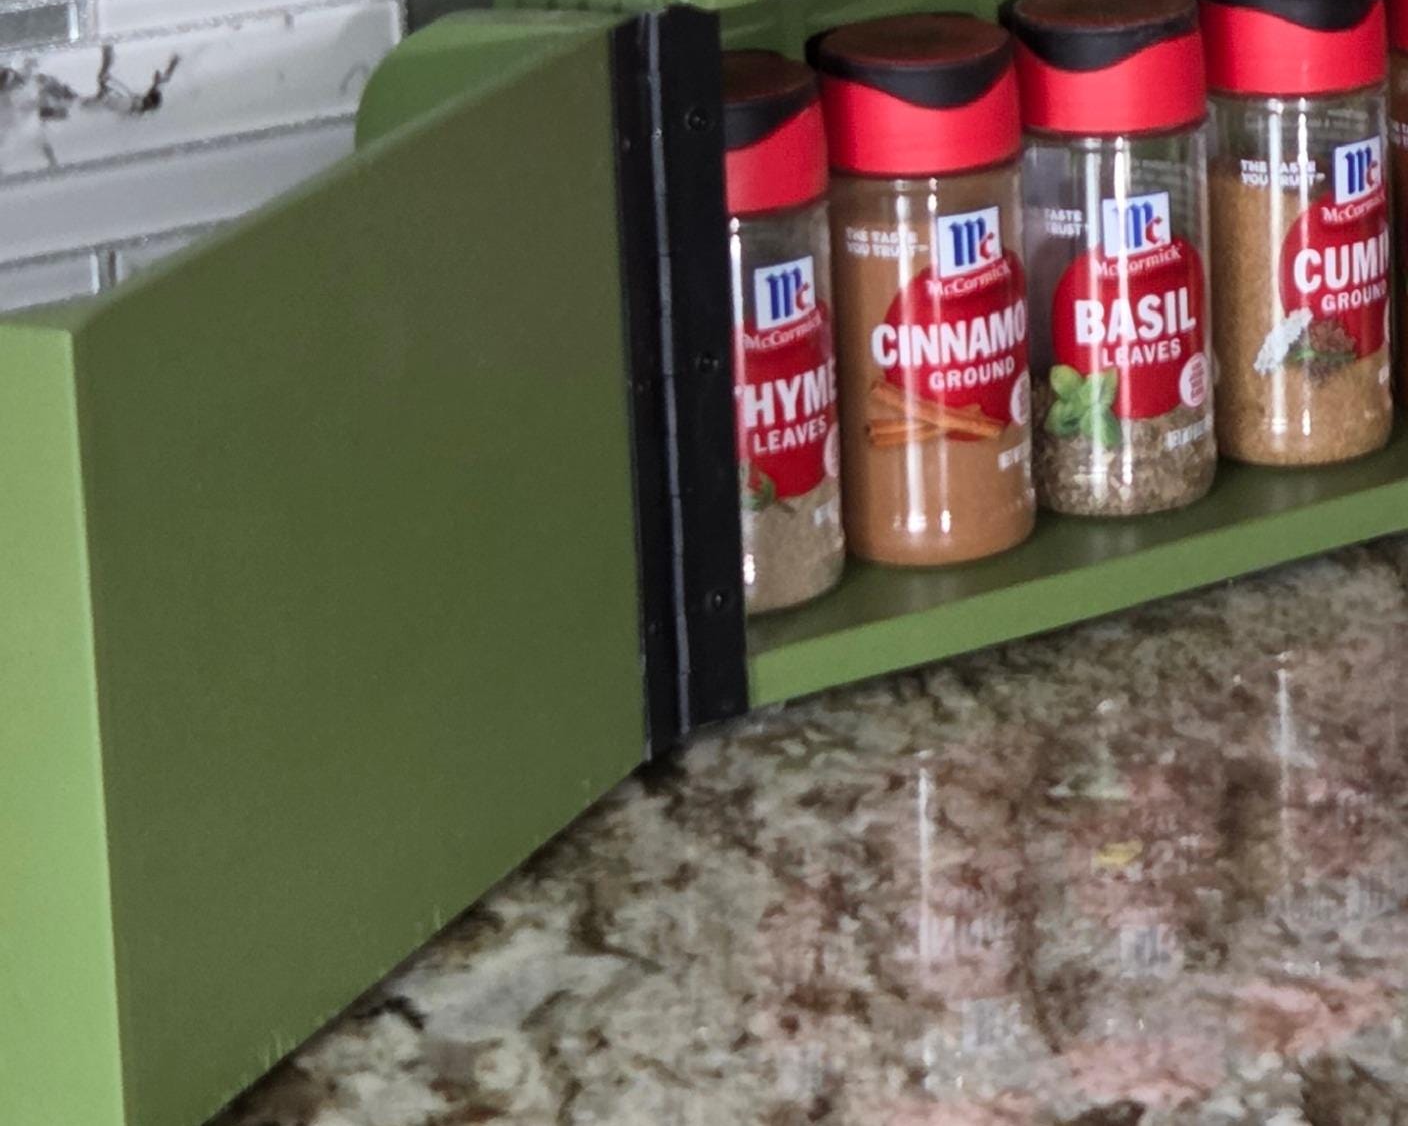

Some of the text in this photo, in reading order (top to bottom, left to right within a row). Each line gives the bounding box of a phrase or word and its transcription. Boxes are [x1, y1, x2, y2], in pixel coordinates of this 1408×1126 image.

[1240, 158, 1268, 173] THE
[1241, 171, 1269, 186] YOU
[1073, 286, 1197, 345] BASIL
[1101, 338, 1182, 369] LEAVES
[928, 355, 1016, 392] GROUND
[753, 415, 827, 456] LEAVES
